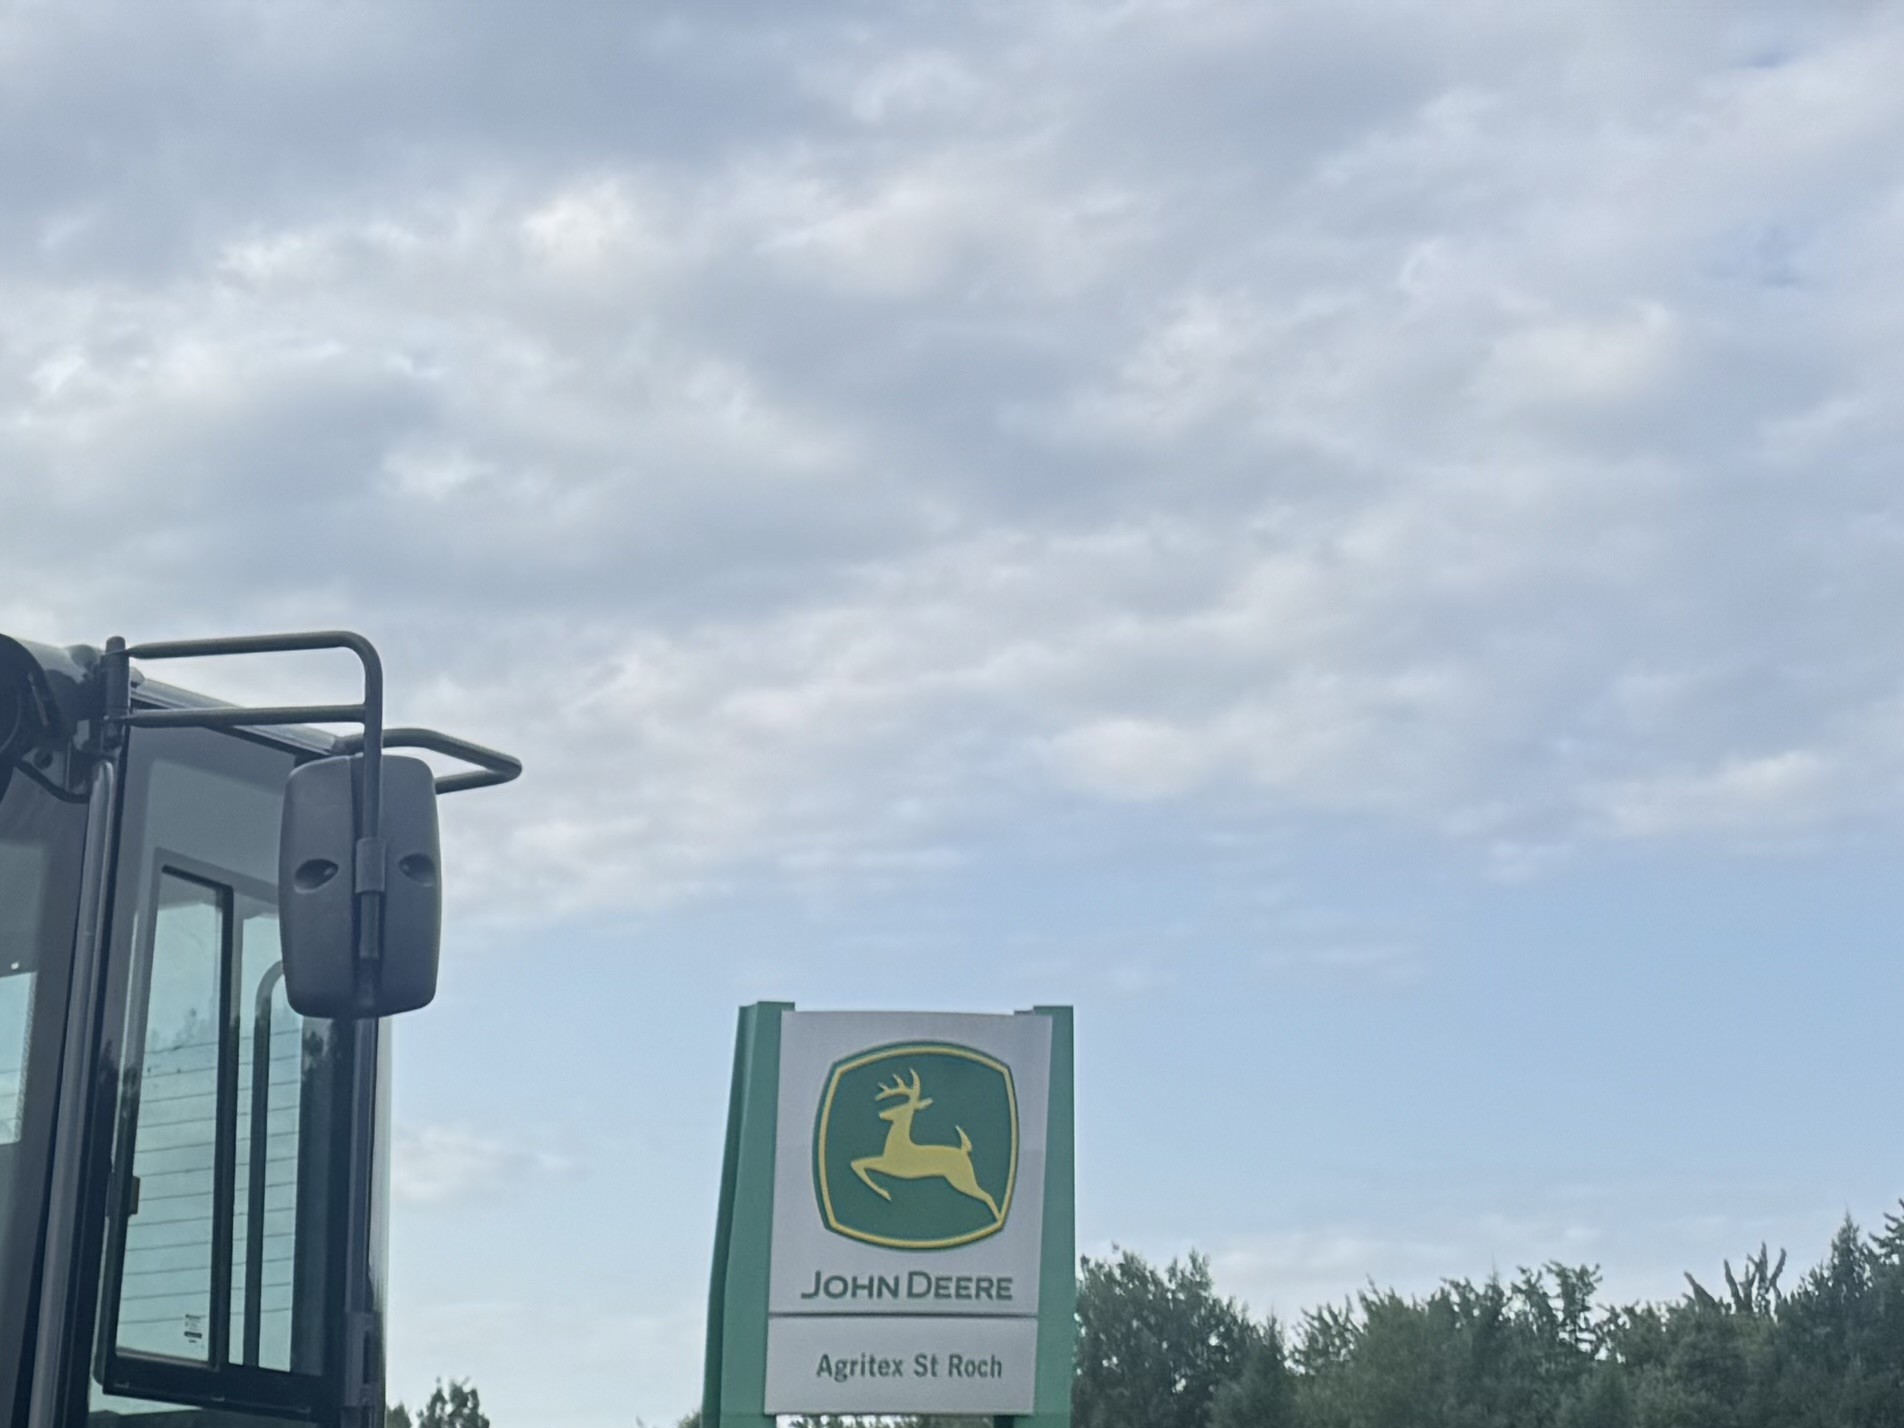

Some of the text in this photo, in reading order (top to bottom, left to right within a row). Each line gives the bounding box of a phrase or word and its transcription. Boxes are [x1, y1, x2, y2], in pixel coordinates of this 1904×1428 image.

[800, 1270, 1014, 1301] JOHN DEERE
[815, 1353, 1003, 1383] Agritex St Roch
